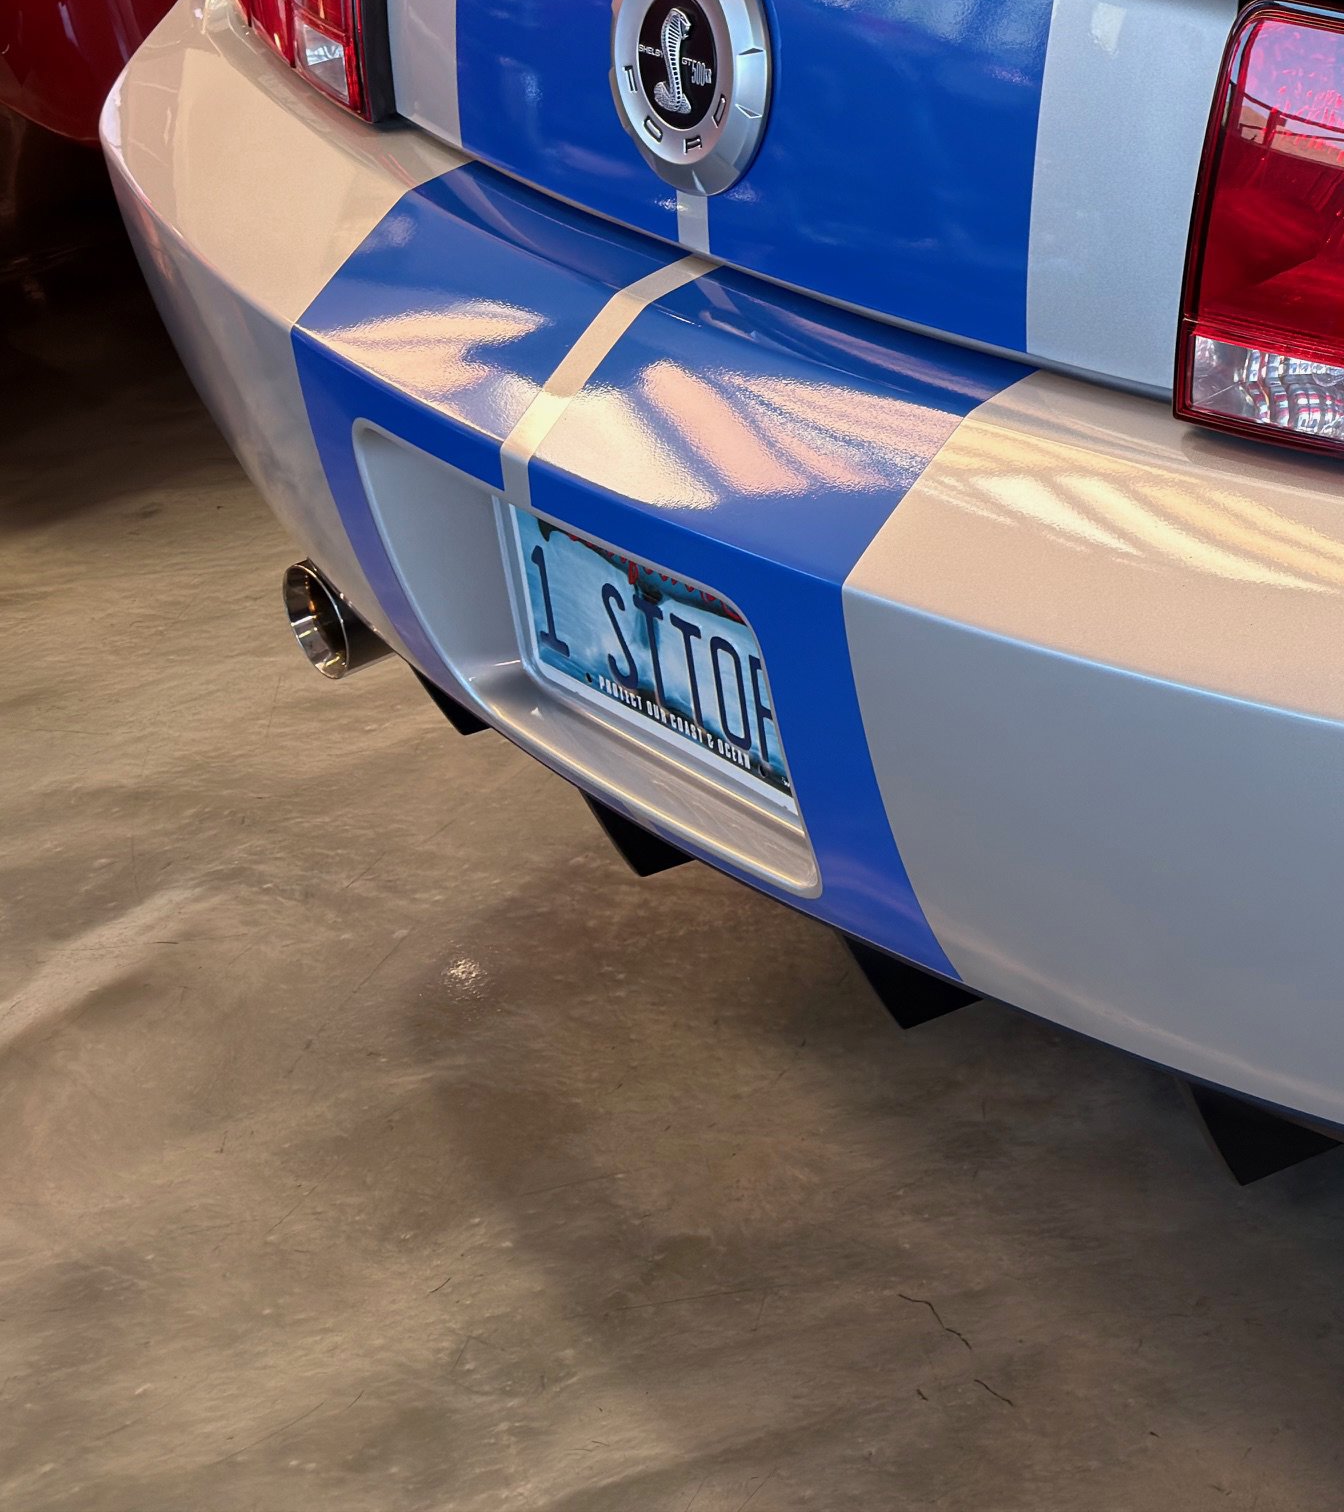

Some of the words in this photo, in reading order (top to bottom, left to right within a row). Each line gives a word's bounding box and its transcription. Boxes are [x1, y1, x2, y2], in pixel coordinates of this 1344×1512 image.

[598, 674, 643, 711] PROTECT
[646, 700, 668, 725] OUR
[669, 714, 704, 744] COAST
[717, 739, 751, 770] OCEAN
